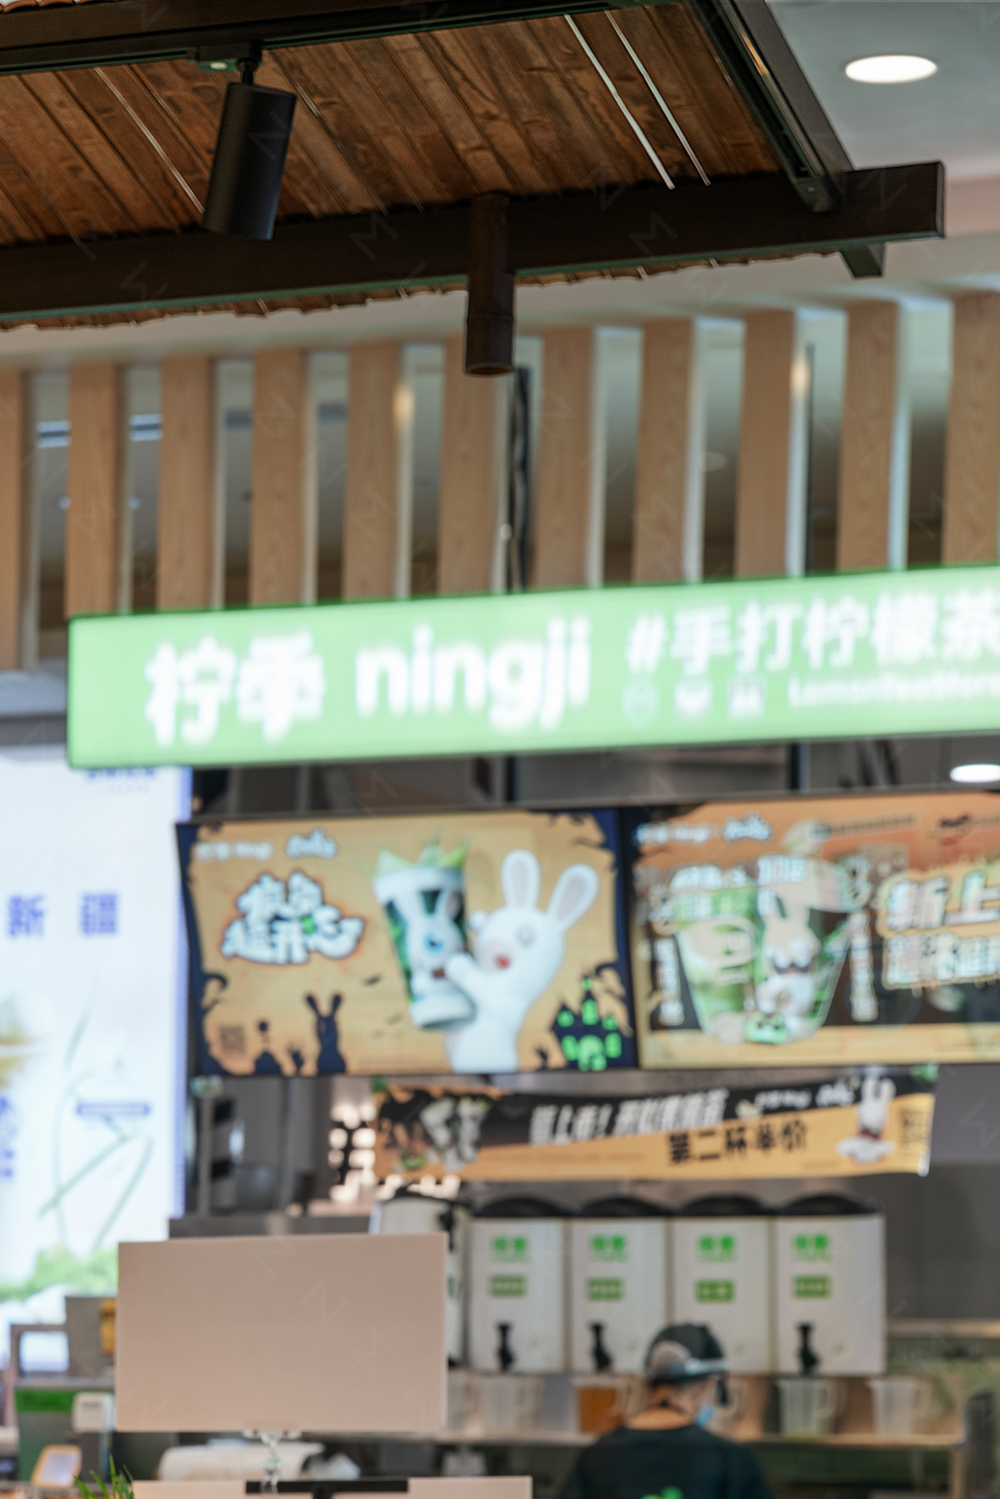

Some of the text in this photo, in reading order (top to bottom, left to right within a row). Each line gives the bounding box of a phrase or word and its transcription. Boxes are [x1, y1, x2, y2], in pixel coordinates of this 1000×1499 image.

[355, 614, 592, 733] ningji
[667, 1116, 809, 1166] 第二杯半价
